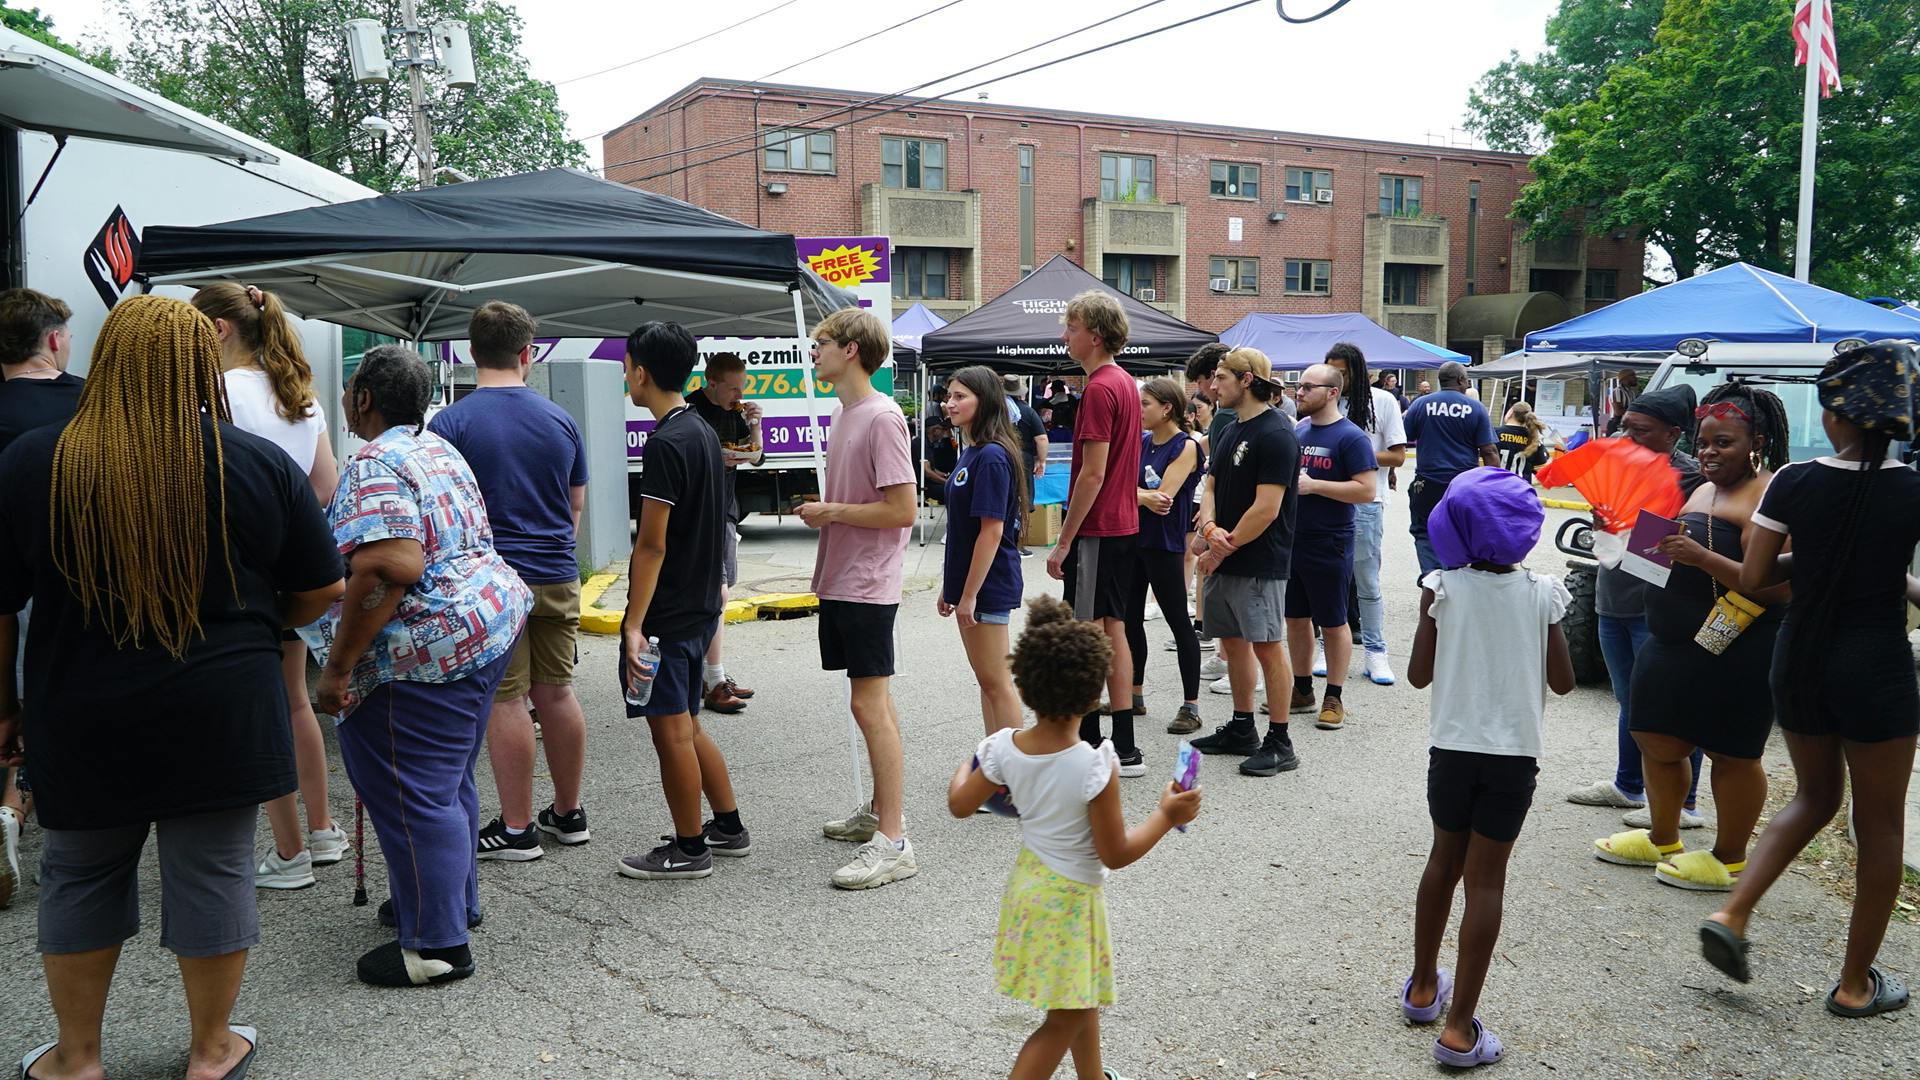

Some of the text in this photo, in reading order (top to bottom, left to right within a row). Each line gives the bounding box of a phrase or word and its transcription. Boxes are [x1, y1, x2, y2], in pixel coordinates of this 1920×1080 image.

[812, 252, 861, 273] FREE
[1426, 402, 1472, 419] HACP
[770, 427, 789, 443] 30
